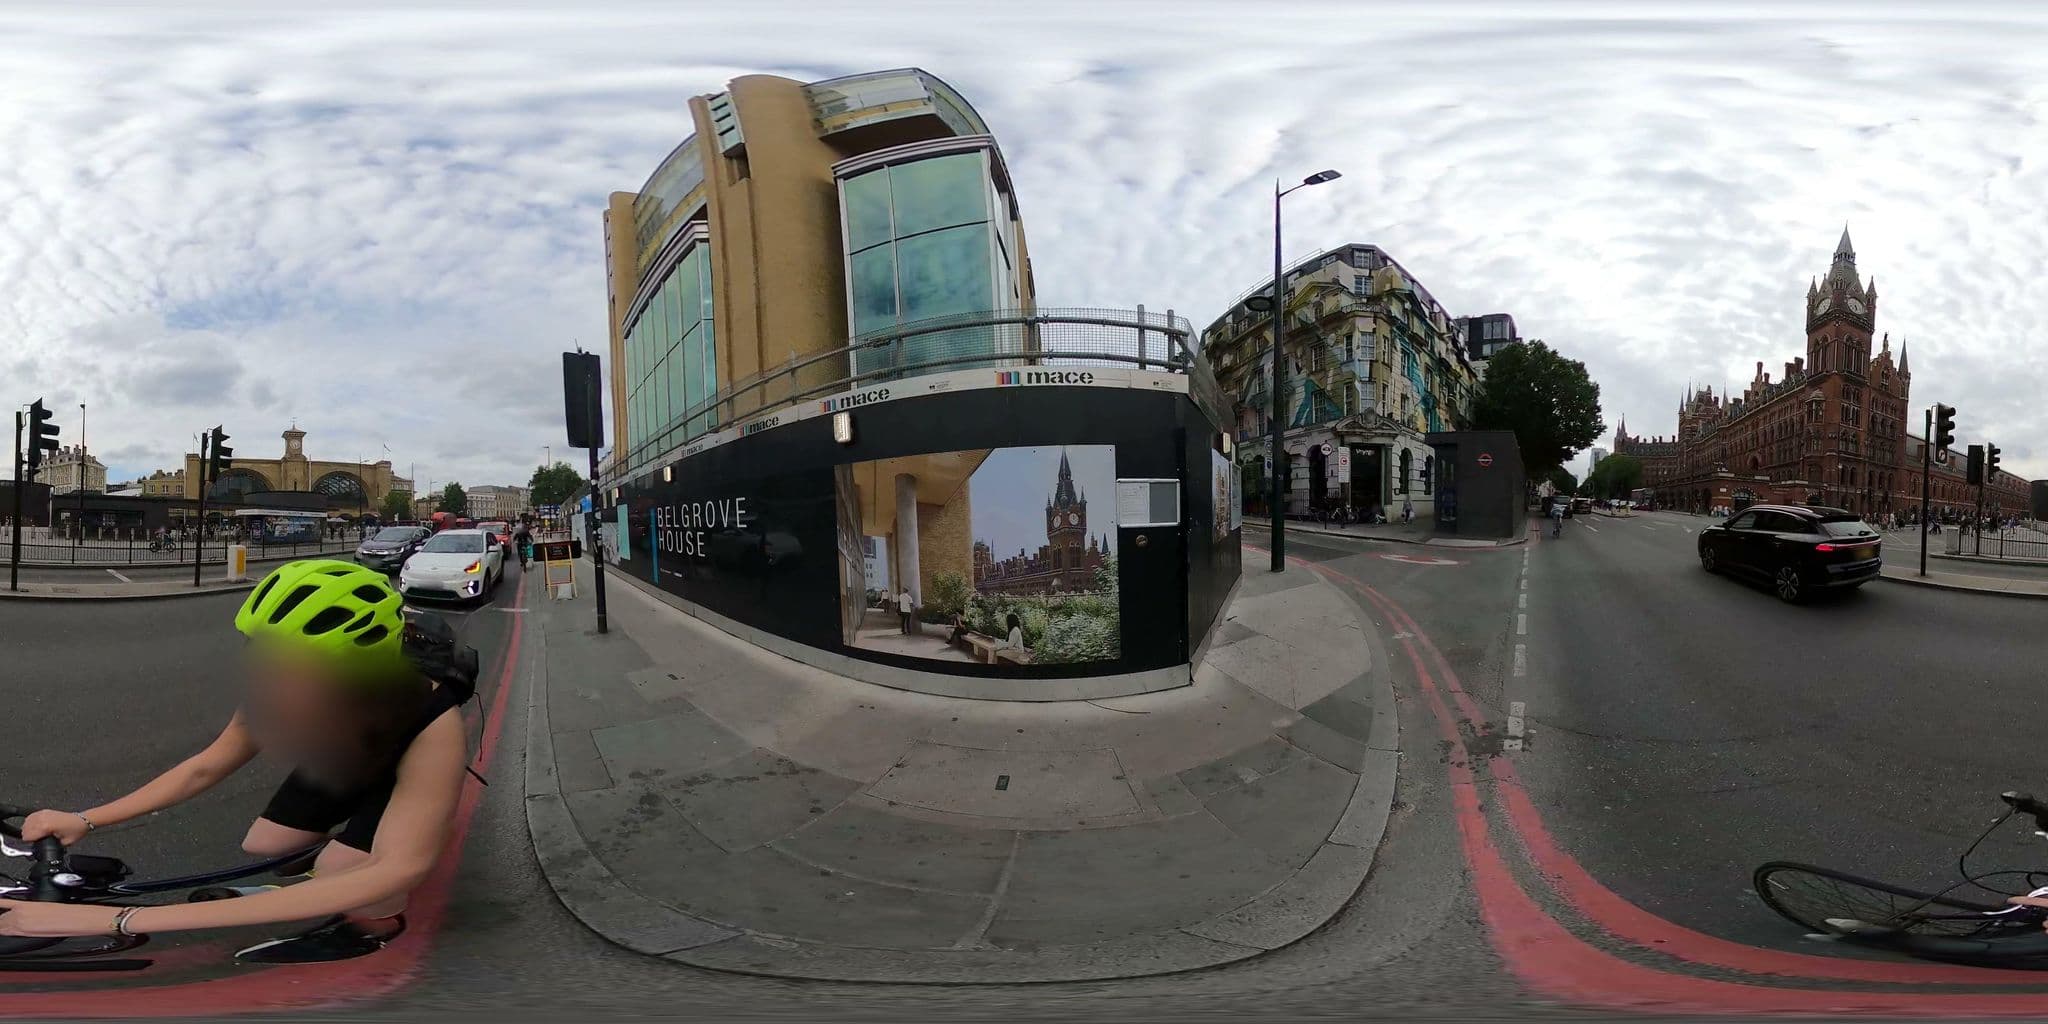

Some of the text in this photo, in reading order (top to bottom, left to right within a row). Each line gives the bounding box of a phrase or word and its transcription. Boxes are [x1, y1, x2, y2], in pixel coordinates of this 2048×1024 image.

[1027, 371, 1094, 384] mace
[840, 388, 890, 409] mace
[750, 415, 779, 433] mace
[657, 497, 748, 528] BELGROVE
[658, 530, 706, 557] HOUSE
